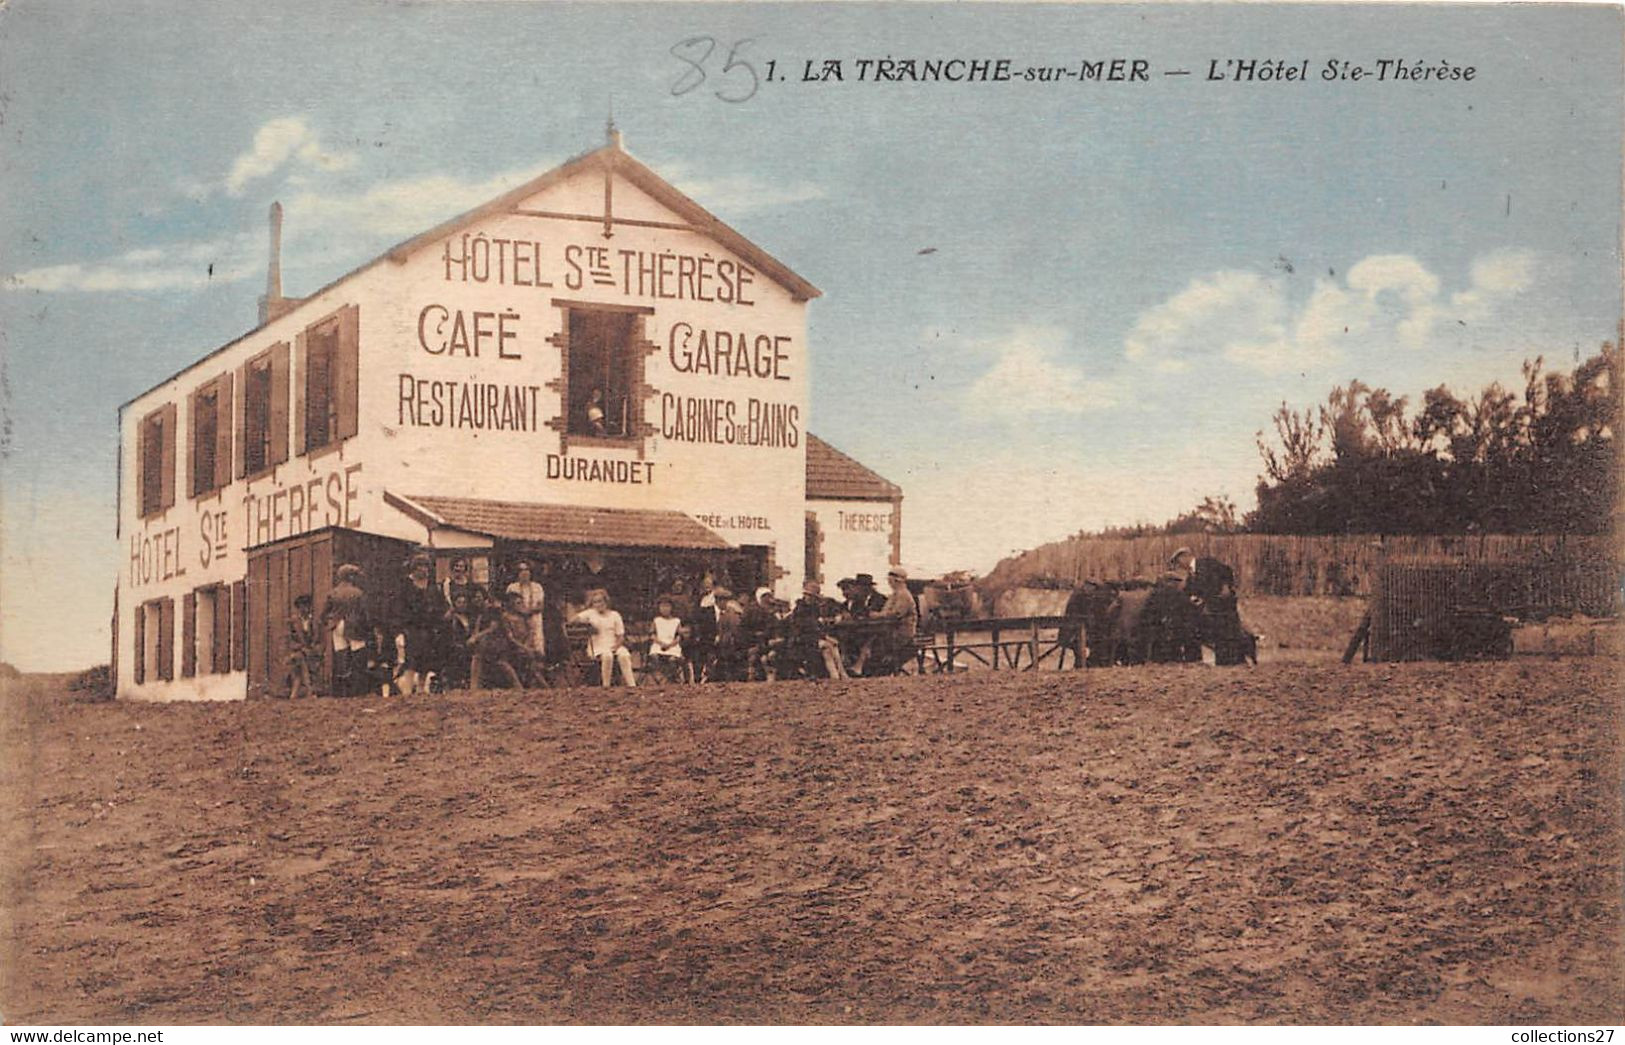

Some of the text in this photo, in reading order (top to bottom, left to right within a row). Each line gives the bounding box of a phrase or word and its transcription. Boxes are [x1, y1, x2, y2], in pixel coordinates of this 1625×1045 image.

[669, 35, 765, 103] 85
[442, 231, 553, 288] HÔTEL
[618, 248, 756, 306] THÉRÈSE
[418, 304, 521, 360] CAFÉ
[669, 322, 792, 380] GARAGE
[399, 373, 540, 432] RESTAURANT
[662, 392, 736, 444] CABINES
[749, 398, 799, 448] BAINS
[546, 454, 655, 484] DURANDET
